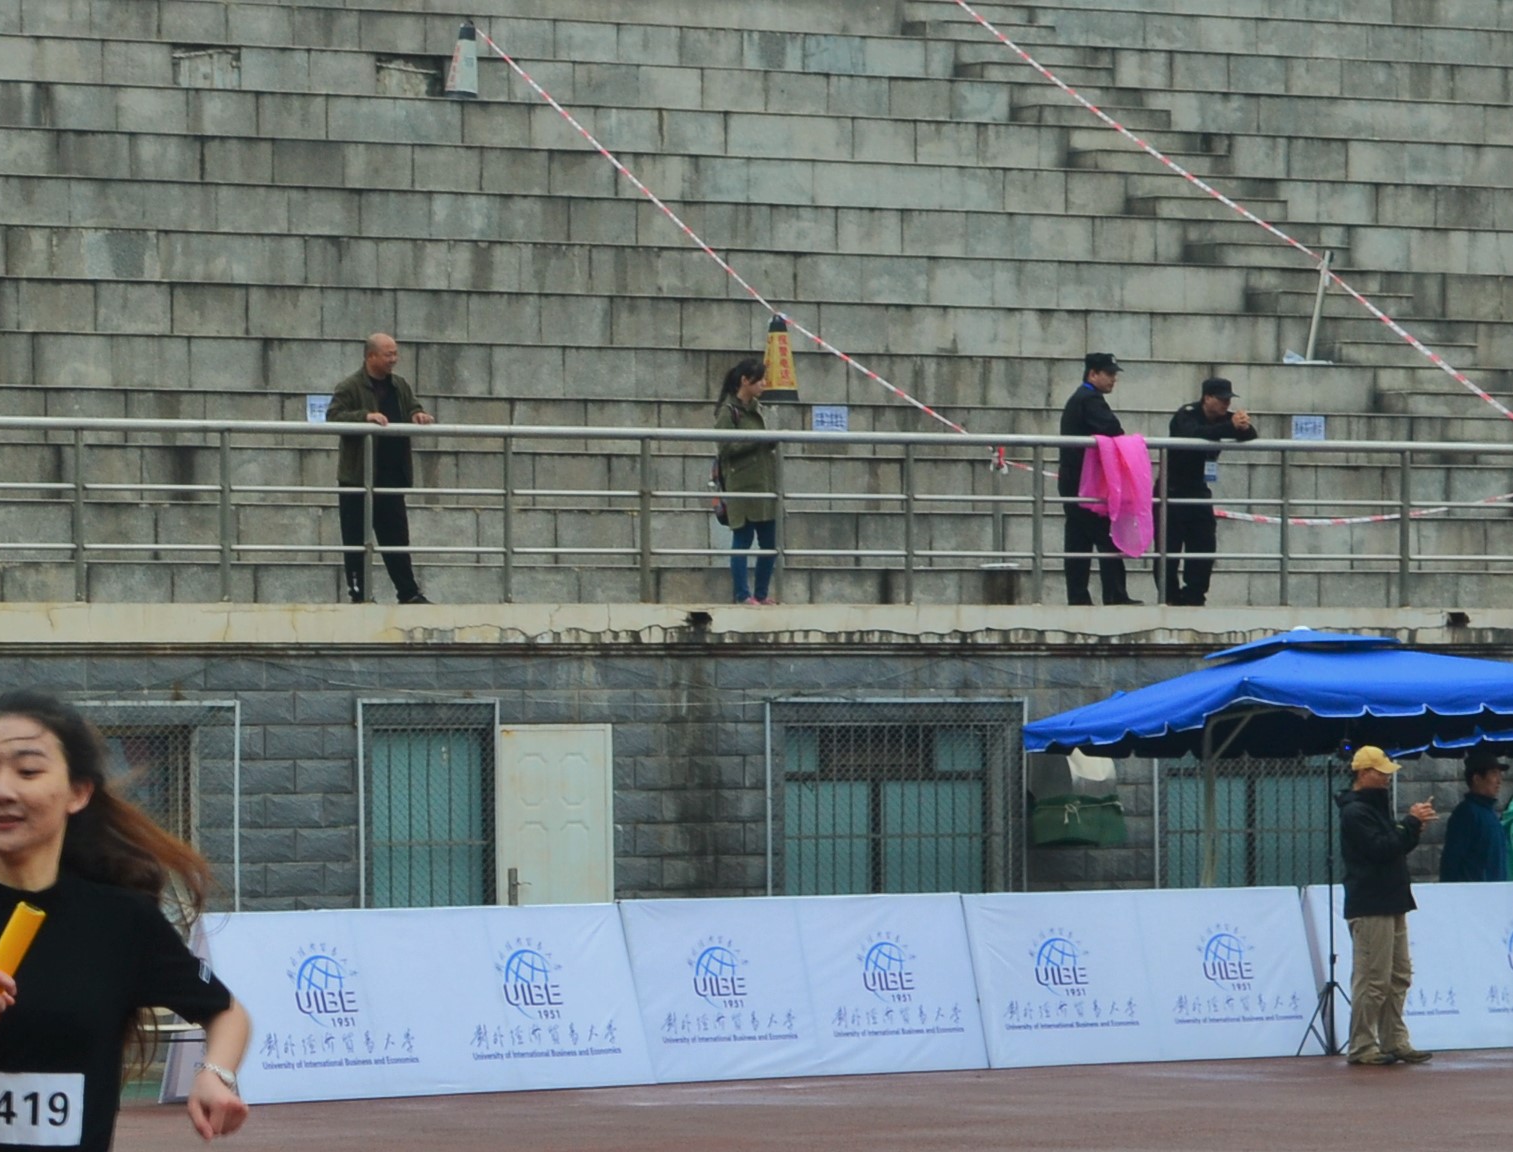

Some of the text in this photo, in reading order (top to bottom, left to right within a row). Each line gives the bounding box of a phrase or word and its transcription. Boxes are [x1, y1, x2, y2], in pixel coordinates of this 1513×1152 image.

[863, 971, 915, 991] UIBE
[1034, 966, 1089, 986] UIBE
[1202, 961, 1254, 981] UIBE
[503, 983, 564, 1006] UIBE
[693, 977, 748, 997] UIBE
[294, 989, 359, 1015] UIBE
[331, 1016, 356, 1027] 1951
[538, 1009, 561, 1019] 1951
